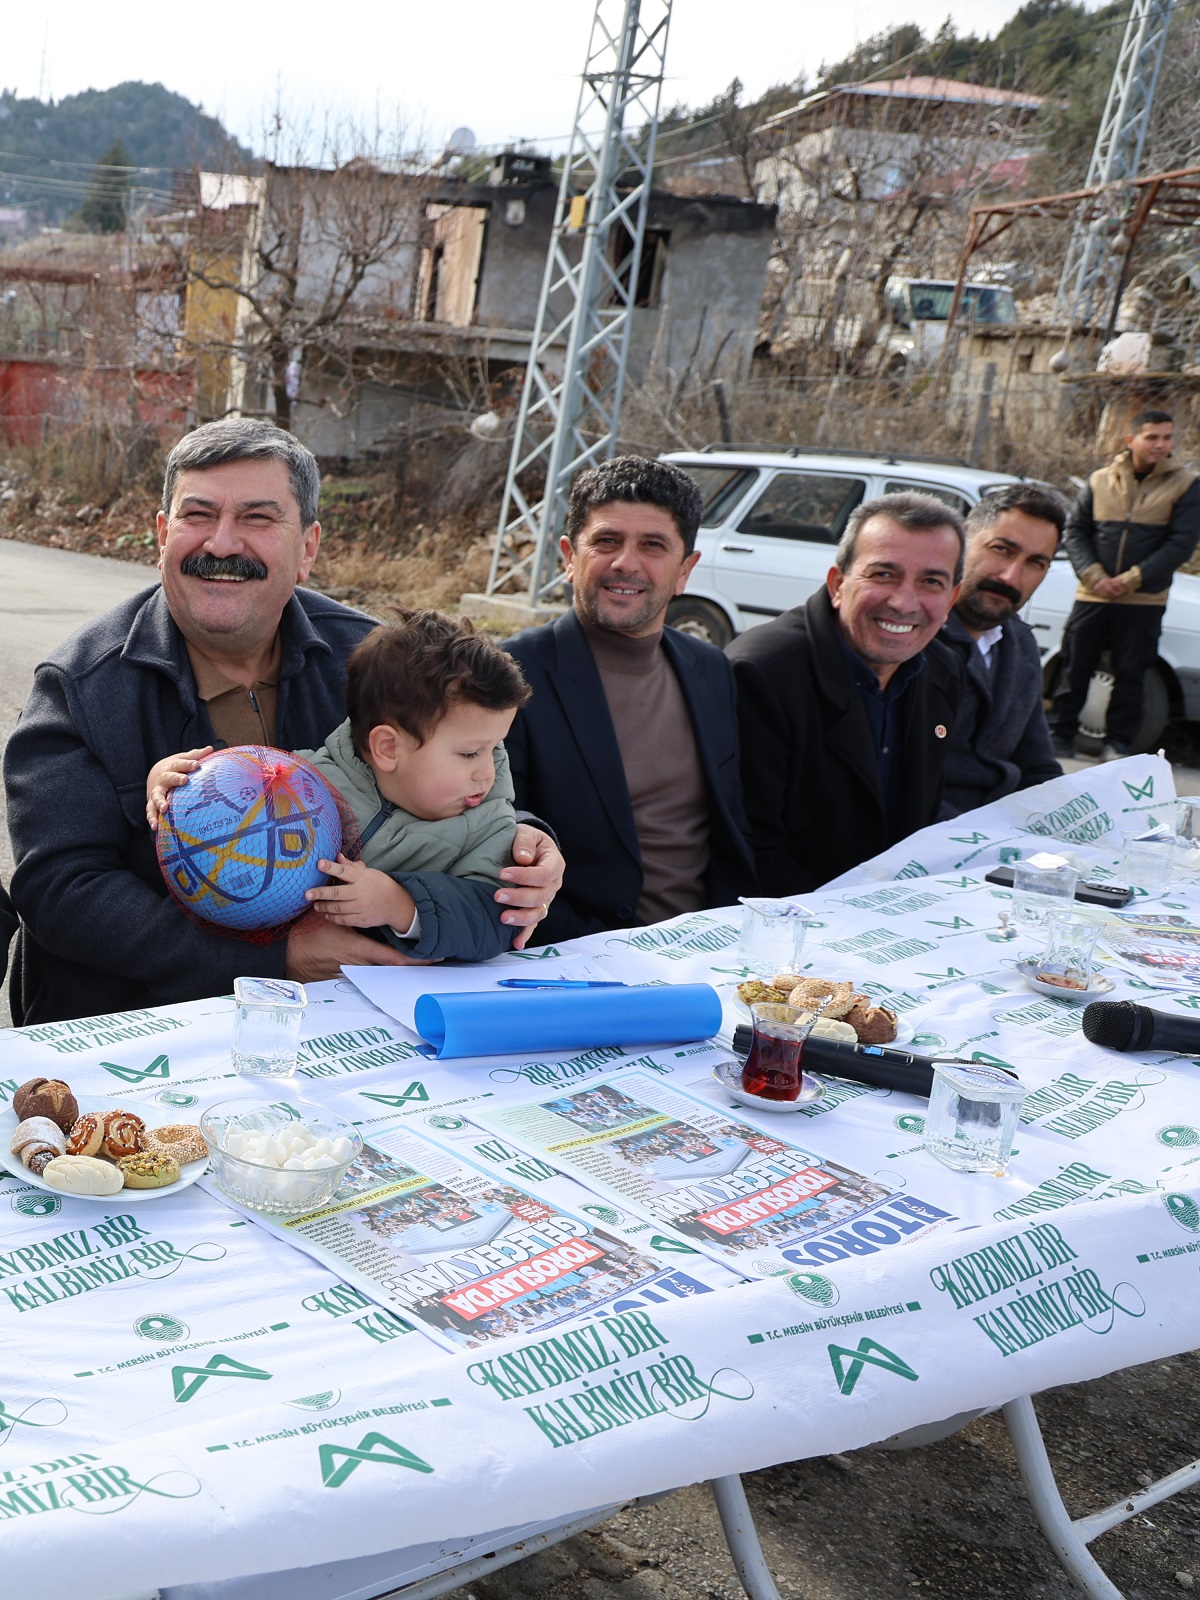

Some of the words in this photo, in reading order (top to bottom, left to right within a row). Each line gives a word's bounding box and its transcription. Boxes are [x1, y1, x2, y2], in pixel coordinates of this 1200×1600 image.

[89, 1017, 191, 1048] KAYBIMIZ
[641, 1184, 730, 1221] VAR!
[699, 1150, 823, 1200] GELECEK
[700, 1169, 835, 1232] TOROSLAR'DA
[90, 1214, 152, 1249] BİR
[381, 1259, 481, 1305] VAR!
[451, 1215, 590, 1276] GELECEK
[781, 1210, 926, 1268] TOROS
[1162, 1243, 1187, 1260] MERSİN
[0, 1254, 140, 1313] KALBİMİZ
[128, 1239, 188, 1272] BİR
[446, 1240, 600, 1315] TOROSLAR'DA
[931, 1234, 1043, 1311] KAYBIMIZ
[1023, 1221, 1079, 1272] BİR
[766, 1330, 784, 1342] T.C.
[783, 1321, 814, 1337] MERSİN
[815, 1310, 865, 1332] BÜYÜKŞEHİR
[864, 1302, 907, 1322] BELEDİYESİ
[972, 1278, 1084, 1358] KALBİMİZ
[1062, 1264, 1118, 1321] BİR
[96, 1364, 117, 1376] T.C.
[117, 1353, 156, 1371] MERSİN
[467, 1325, 620, 1402] KAYBIMIZ
[233, 1438, 254, 1452] T.C.
[254, 1427, 300, 1448] MERSİN
[300, 1409, 371, 1435] BÜYÜKŞEHİR
[372, 1399, 430, 1421] BELEDİYESİ
[523, 1368, 668, 1449] KALBİMİZ
[651, 1351, 714, 1409] BİR
[62, 1466, 152, 1505] BİR
